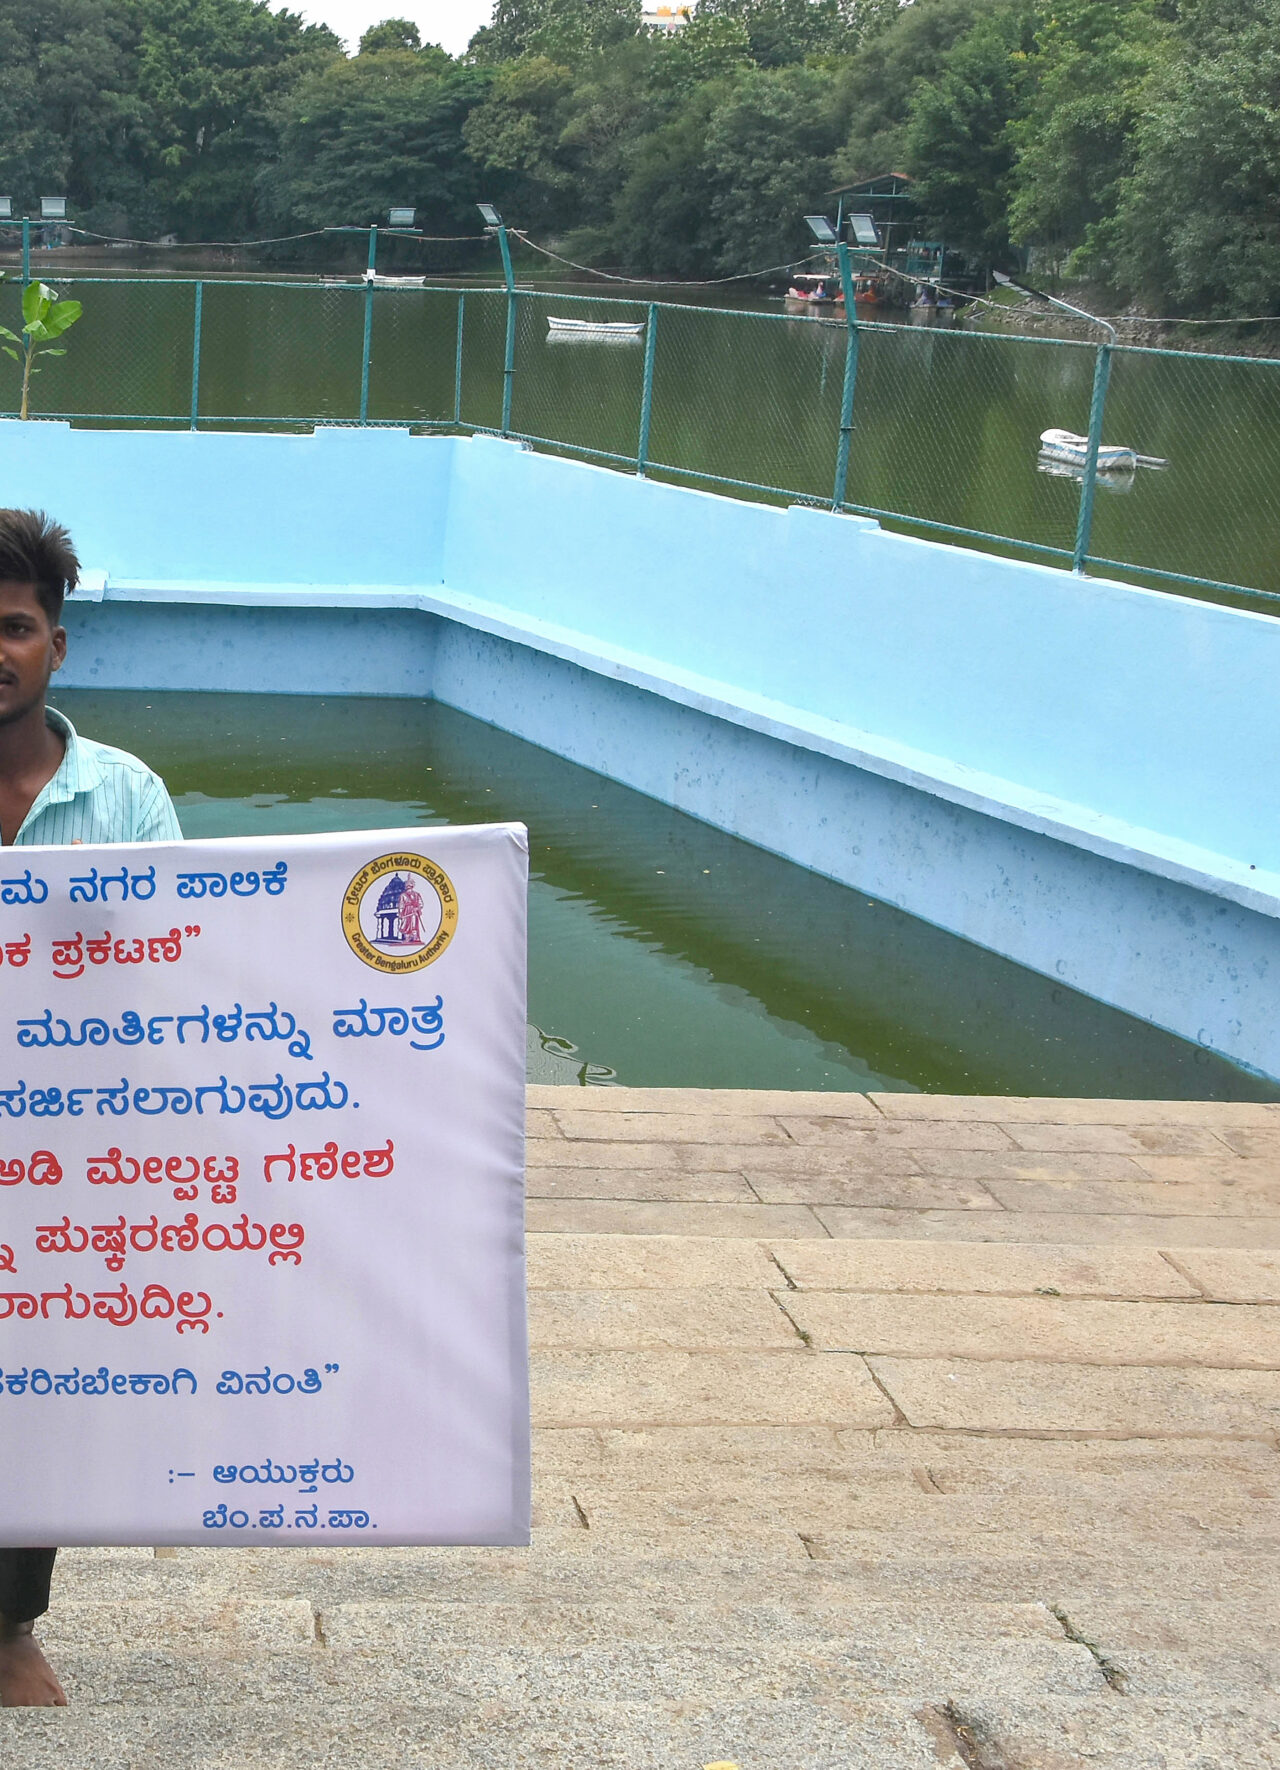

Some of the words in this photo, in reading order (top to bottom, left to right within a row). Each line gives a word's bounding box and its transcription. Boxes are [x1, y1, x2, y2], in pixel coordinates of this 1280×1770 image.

[68, 866, 157, 904] ನಗರ
[175, 860, 289, 899] ಪಾಲಿಕೆ
[352, 932, 375, 960] Greater
[375, 955, 418, 971] Bengaluru
[419, 930, 450, 963] Authority
[16, 1001, 314, 1061] ಮೂರ್ತಿಗಳನ್ನು
[332, 994, 446, 1051] ಮಾತ್ರ
[86, 1146, 240, 1205] ಮೇಲ್ಪಟ್ಟ
[263, 1138, 395, 1183] ಗಣೇಶ
[35, 1212, 305, 1273] ಪುಷ್ಕರಣಿಯಲ್ಲಿ
[212, 1457, 355, 1494] ಆಯುಕ್ತರು
[201, 1503, 378, 1529] ಬೆಂ.ಪ.ನ.ಪಾ.
